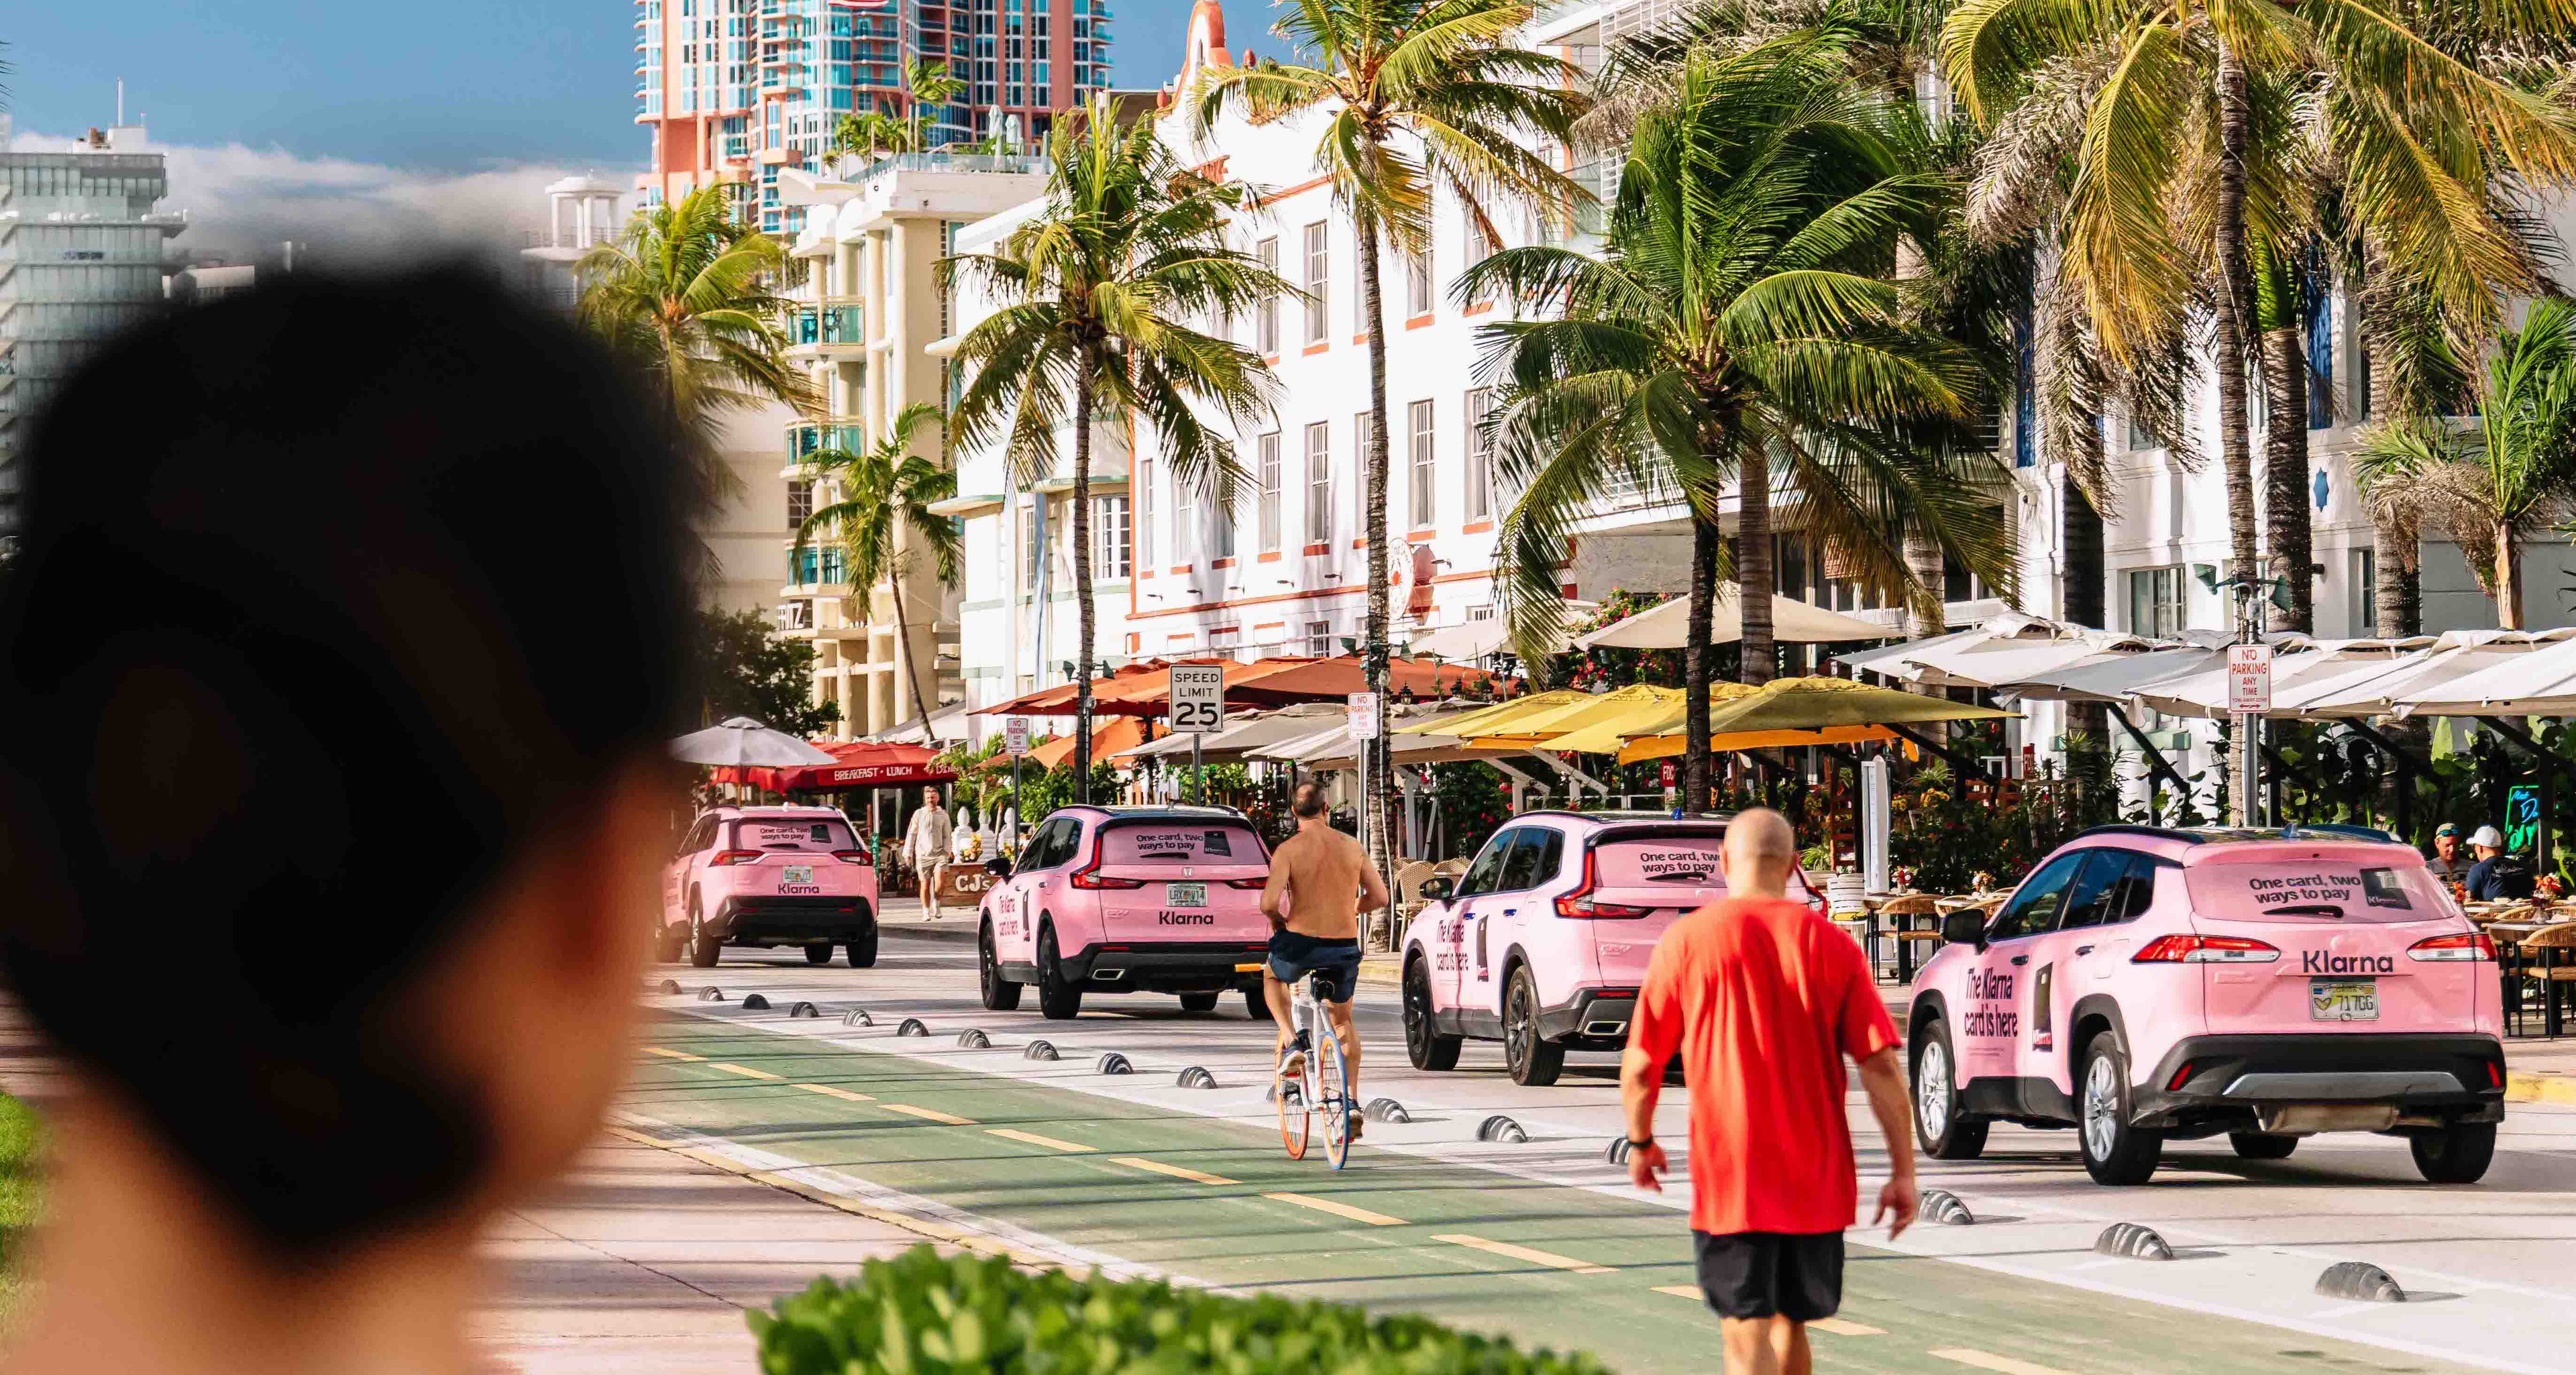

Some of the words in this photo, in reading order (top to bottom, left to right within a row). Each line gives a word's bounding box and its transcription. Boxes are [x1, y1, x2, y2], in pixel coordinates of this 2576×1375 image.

[2241, 649, 2257, 661] NO
[2232, 663, 2267, 675] PARKING
[1175, 673, 1219, 683] SPEED
[2243, 677, 2257, 685] ANY
[1179, 688, 1214, 697] LIMIT
[2243, 688, 2258, 696] TIME
[1357, 696, 1368, 704] NO
[1175, 702, 1218, 726] 25
[1351, 704, 1375, 714] PARKING
[834, 768, 878, 781] BREAKFAST
[885, 766, 913, 777] LUNCH
[1662, 765, 1674, 781] FDC
[1157, 833, 1183, 842] card,
[1138, 842, 1164, 850] ways
[1640, 852, 1666, 862] One
[1668, 851, 1700, 862] card,
[1642, 864, 1676, 873] ways
[1676, 863, 1691, 871] to
[1693, 863, 1716, 873] pay
[955, 874, 990, 891] CJ's
[2249, 878, 2284, 890] One
[2286, 875, 2328, 887] card,
[2328, 875, 2361, 886] two
[777, 884, 820, 894] Klarna
[2255, 890, 2300, 903] ways
[2300, 889, 2319, 899] to
[2320, 889, 2351, 900] pay
[1159, 911, 1214, 925] Klarna
[2302, 950, 2394, 973] Klarna
[1966, 967, 1981, 999] The
[1982, 967, 2013, 999] Klarna
[1964, 1004, 1984, 1037] card
[1985, 1003, 1994, 1037] is
[1995, 1004, 2018, 1037] here
